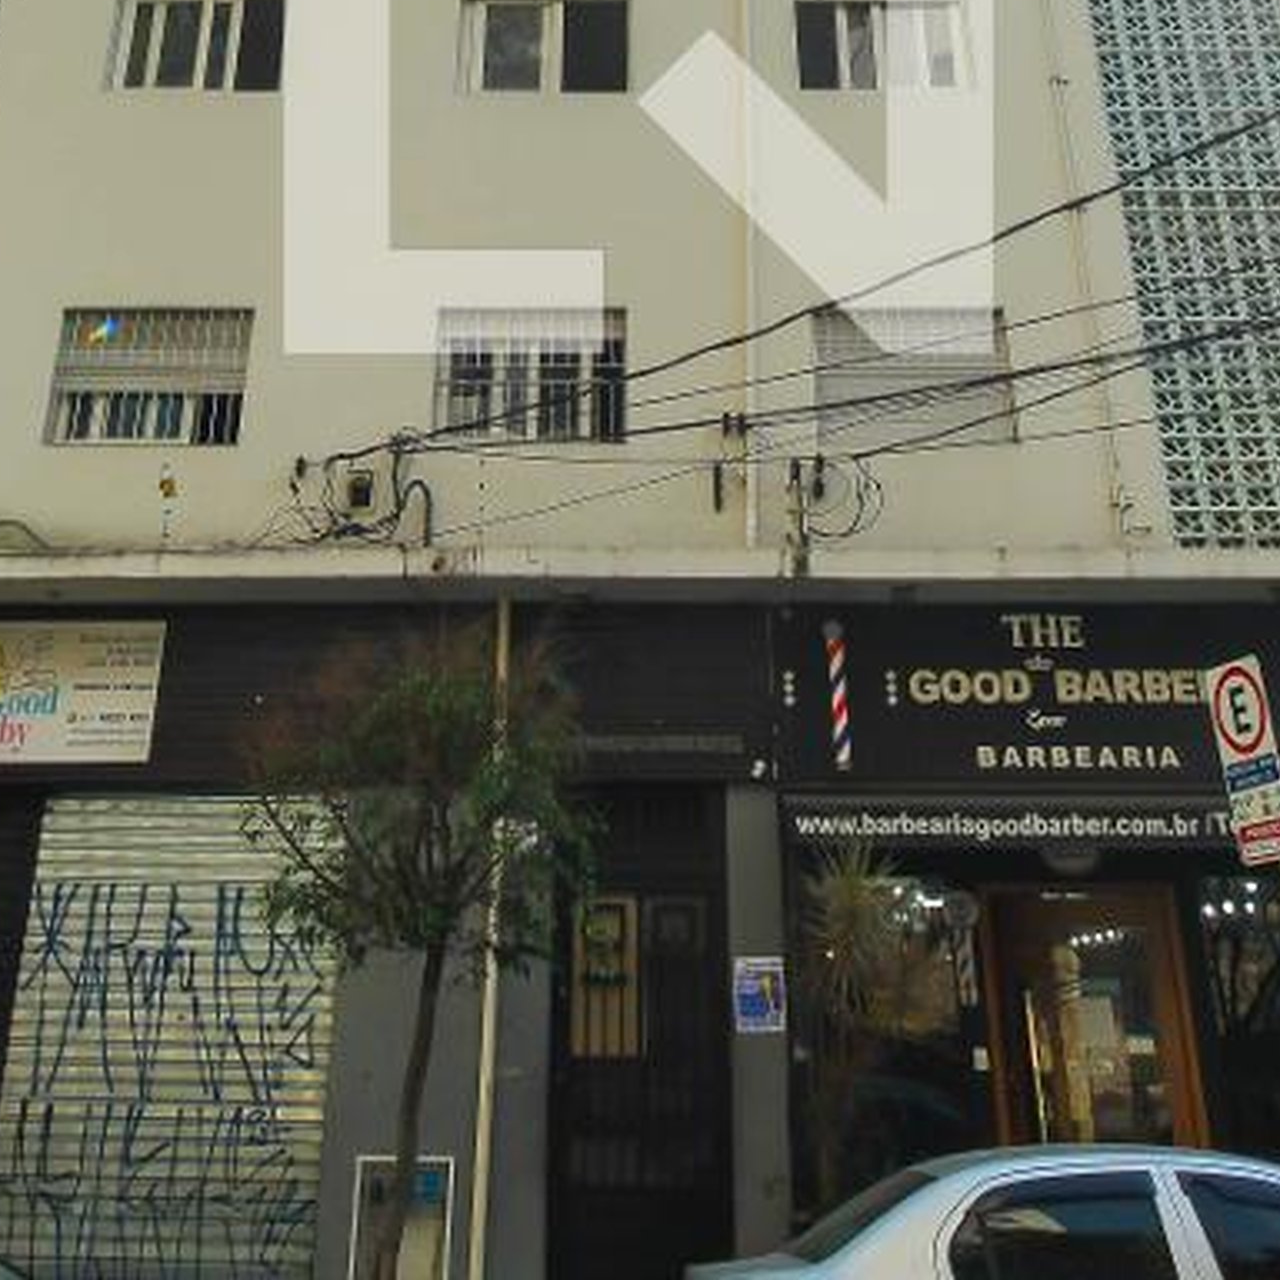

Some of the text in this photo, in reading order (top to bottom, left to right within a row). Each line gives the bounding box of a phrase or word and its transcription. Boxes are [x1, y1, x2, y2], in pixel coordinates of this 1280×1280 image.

[1001, 614, 1085, 649] THE
[908, 669, 1210, 704] GOOD BARBE
[1227, 685, 1253, 736] E
[976, 745, 1182, 770] BARBEARIA
[796, 812, 1199, 842] www.barbeariagoodbarber.com.br
